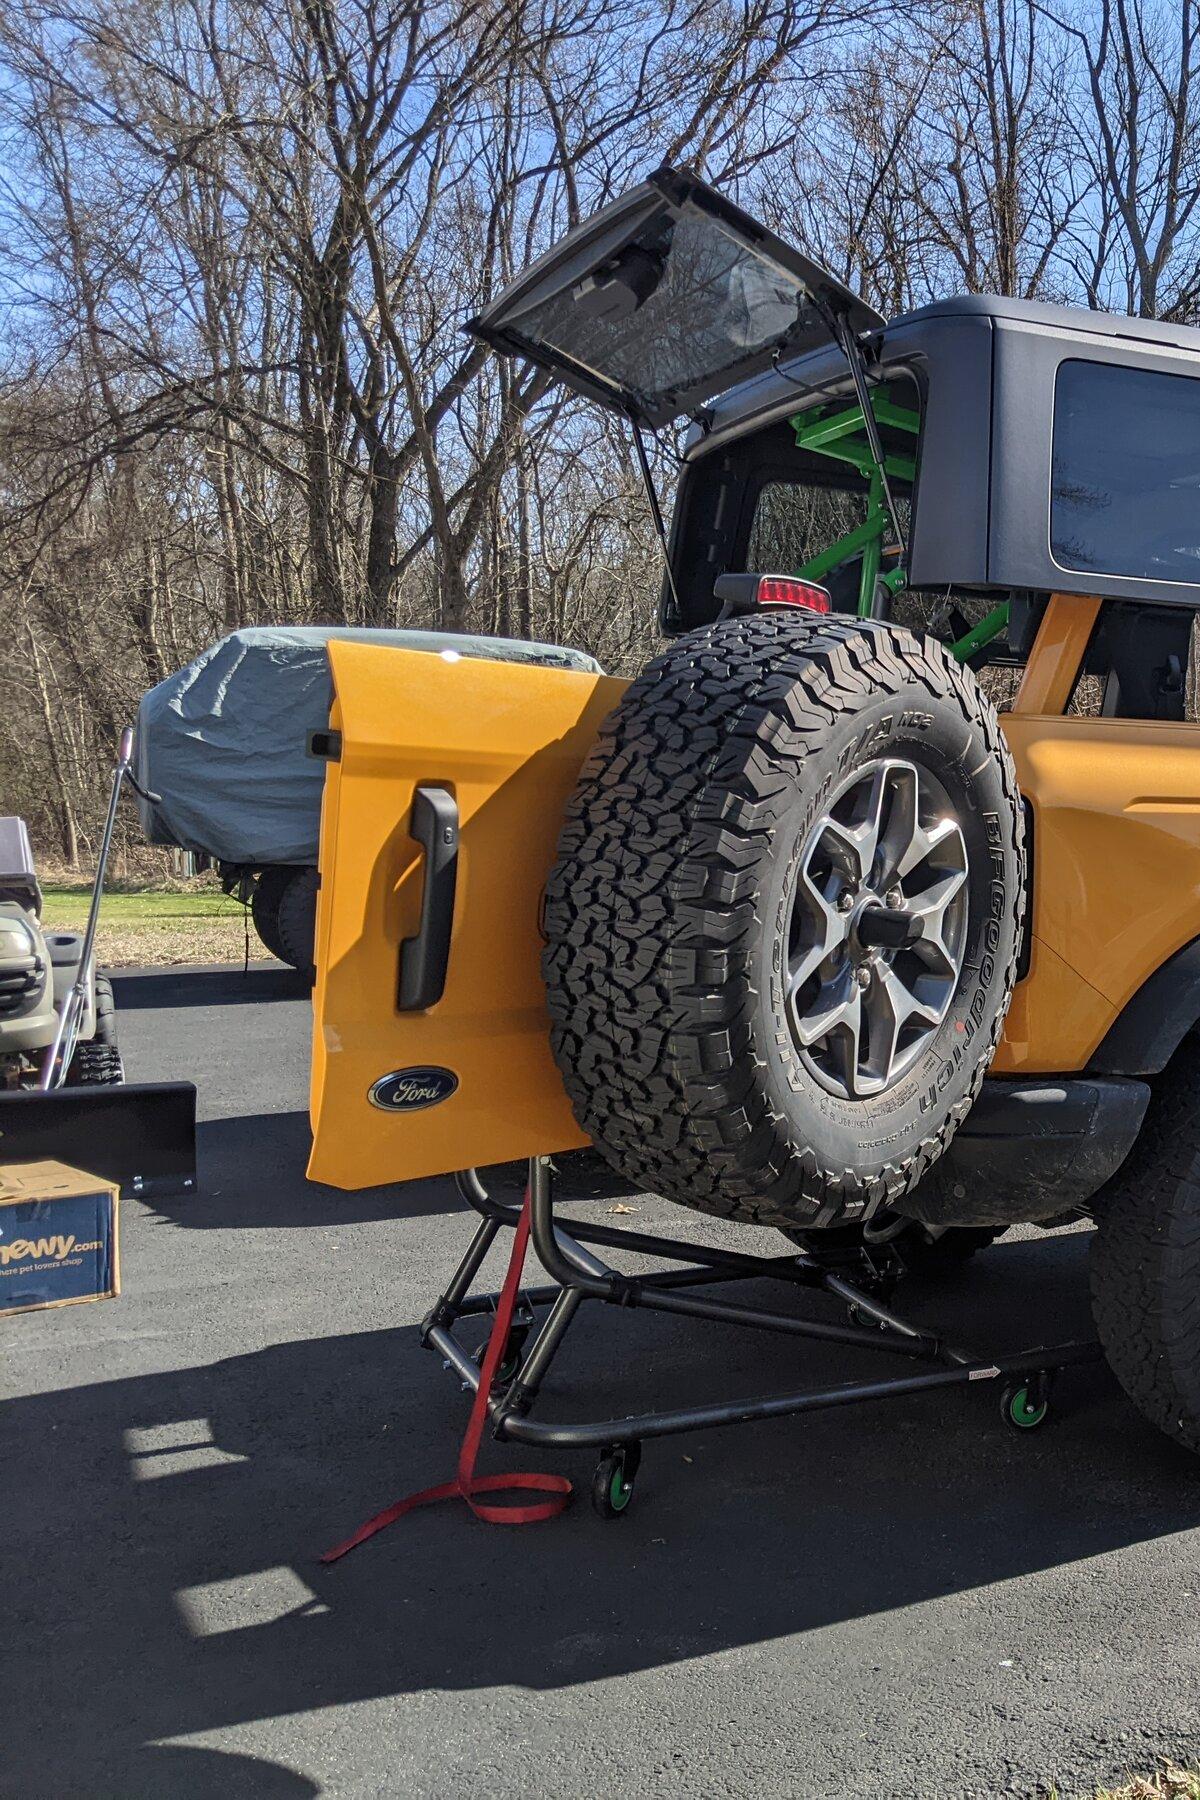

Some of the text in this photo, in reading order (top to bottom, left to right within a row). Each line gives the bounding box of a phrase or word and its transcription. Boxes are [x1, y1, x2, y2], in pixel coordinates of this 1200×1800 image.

[837, 714, 894, 775] T/A
[918, 811, 1006, 1114] BFGoodrich
[392, 1077, 442, 1103] Ford
[19, 1264, 33, 1275] pet
[34, 1261, 60, 1270] lovers
[61, 1258, 83, 1266] shop
